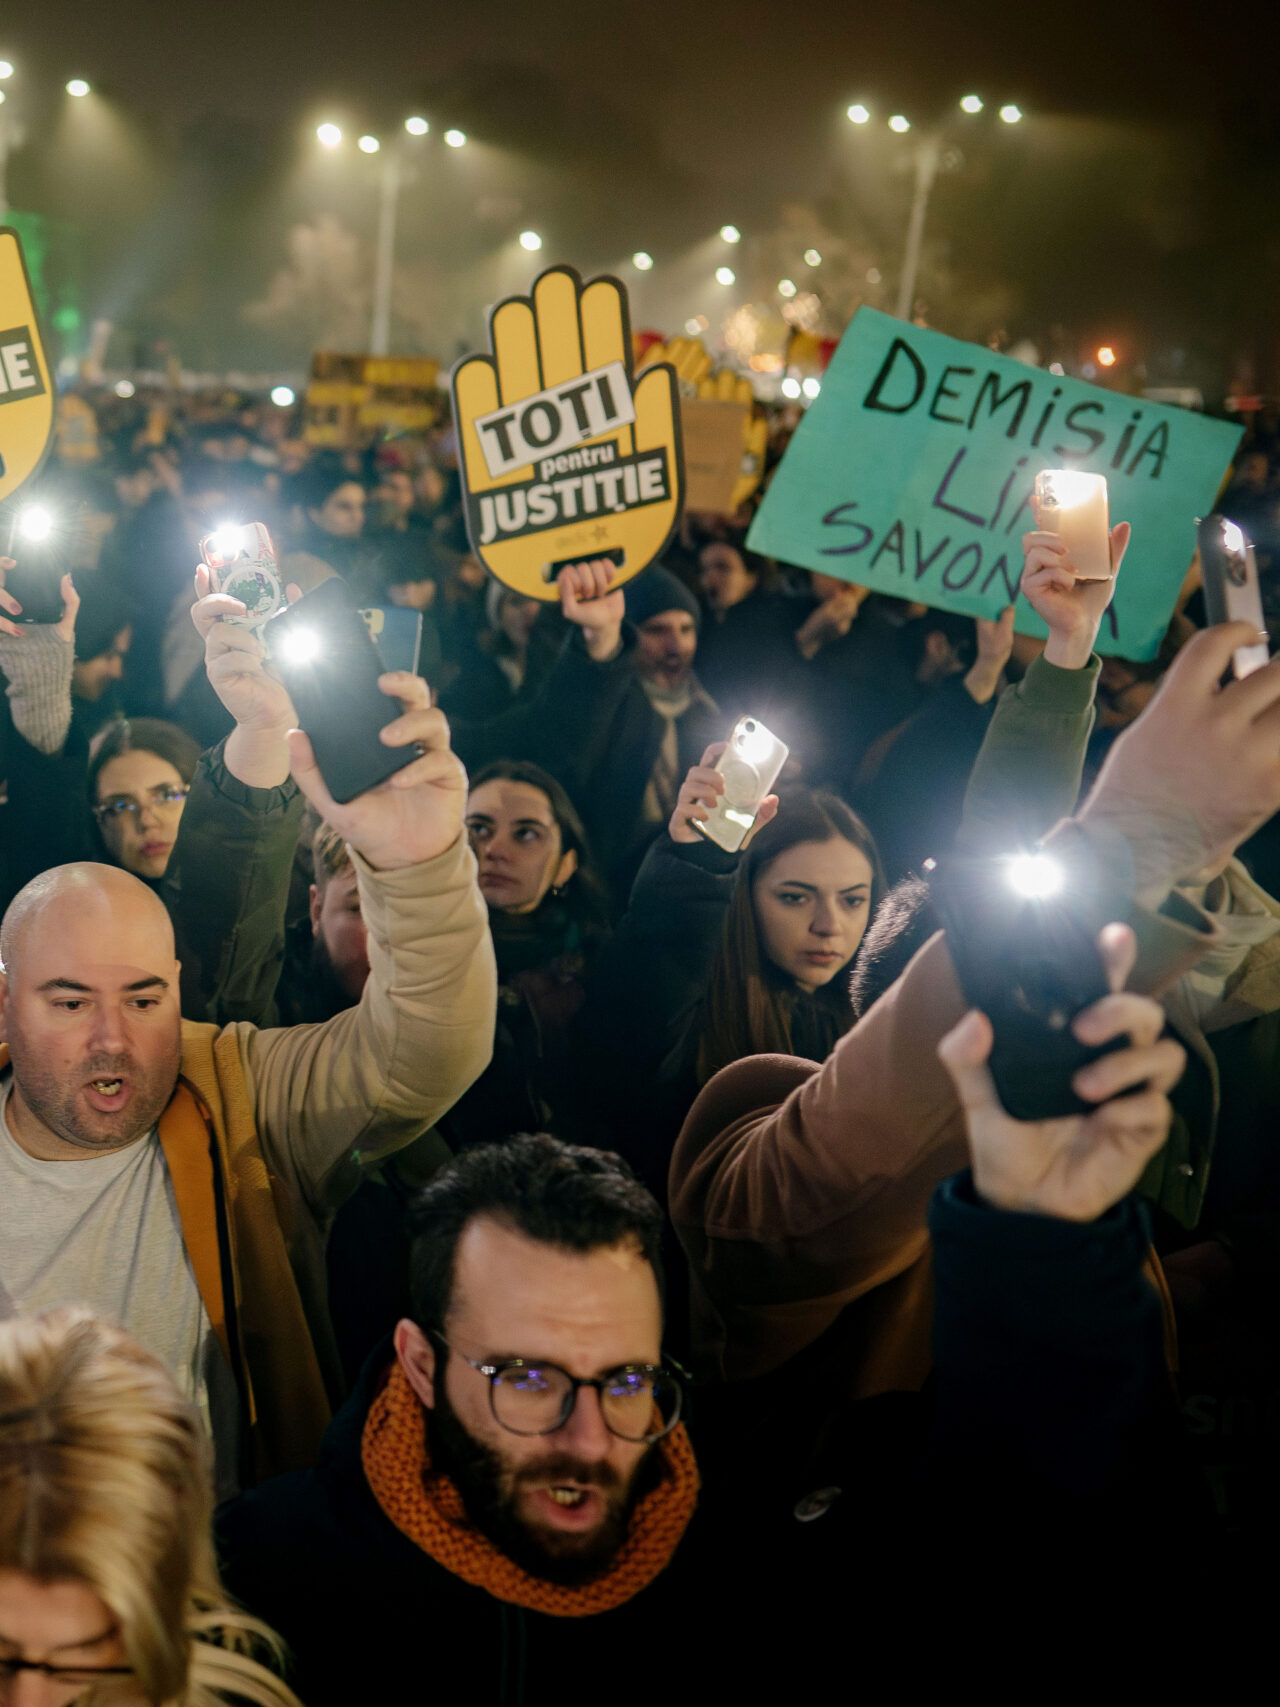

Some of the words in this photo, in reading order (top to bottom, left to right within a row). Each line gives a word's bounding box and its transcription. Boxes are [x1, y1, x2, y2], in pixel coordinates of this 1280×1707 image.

[482, 374, 618, 463] TOȚI
[540, 441, 615, 481] pentru
[478, 457, 665, 545] JUSTIȚIE
